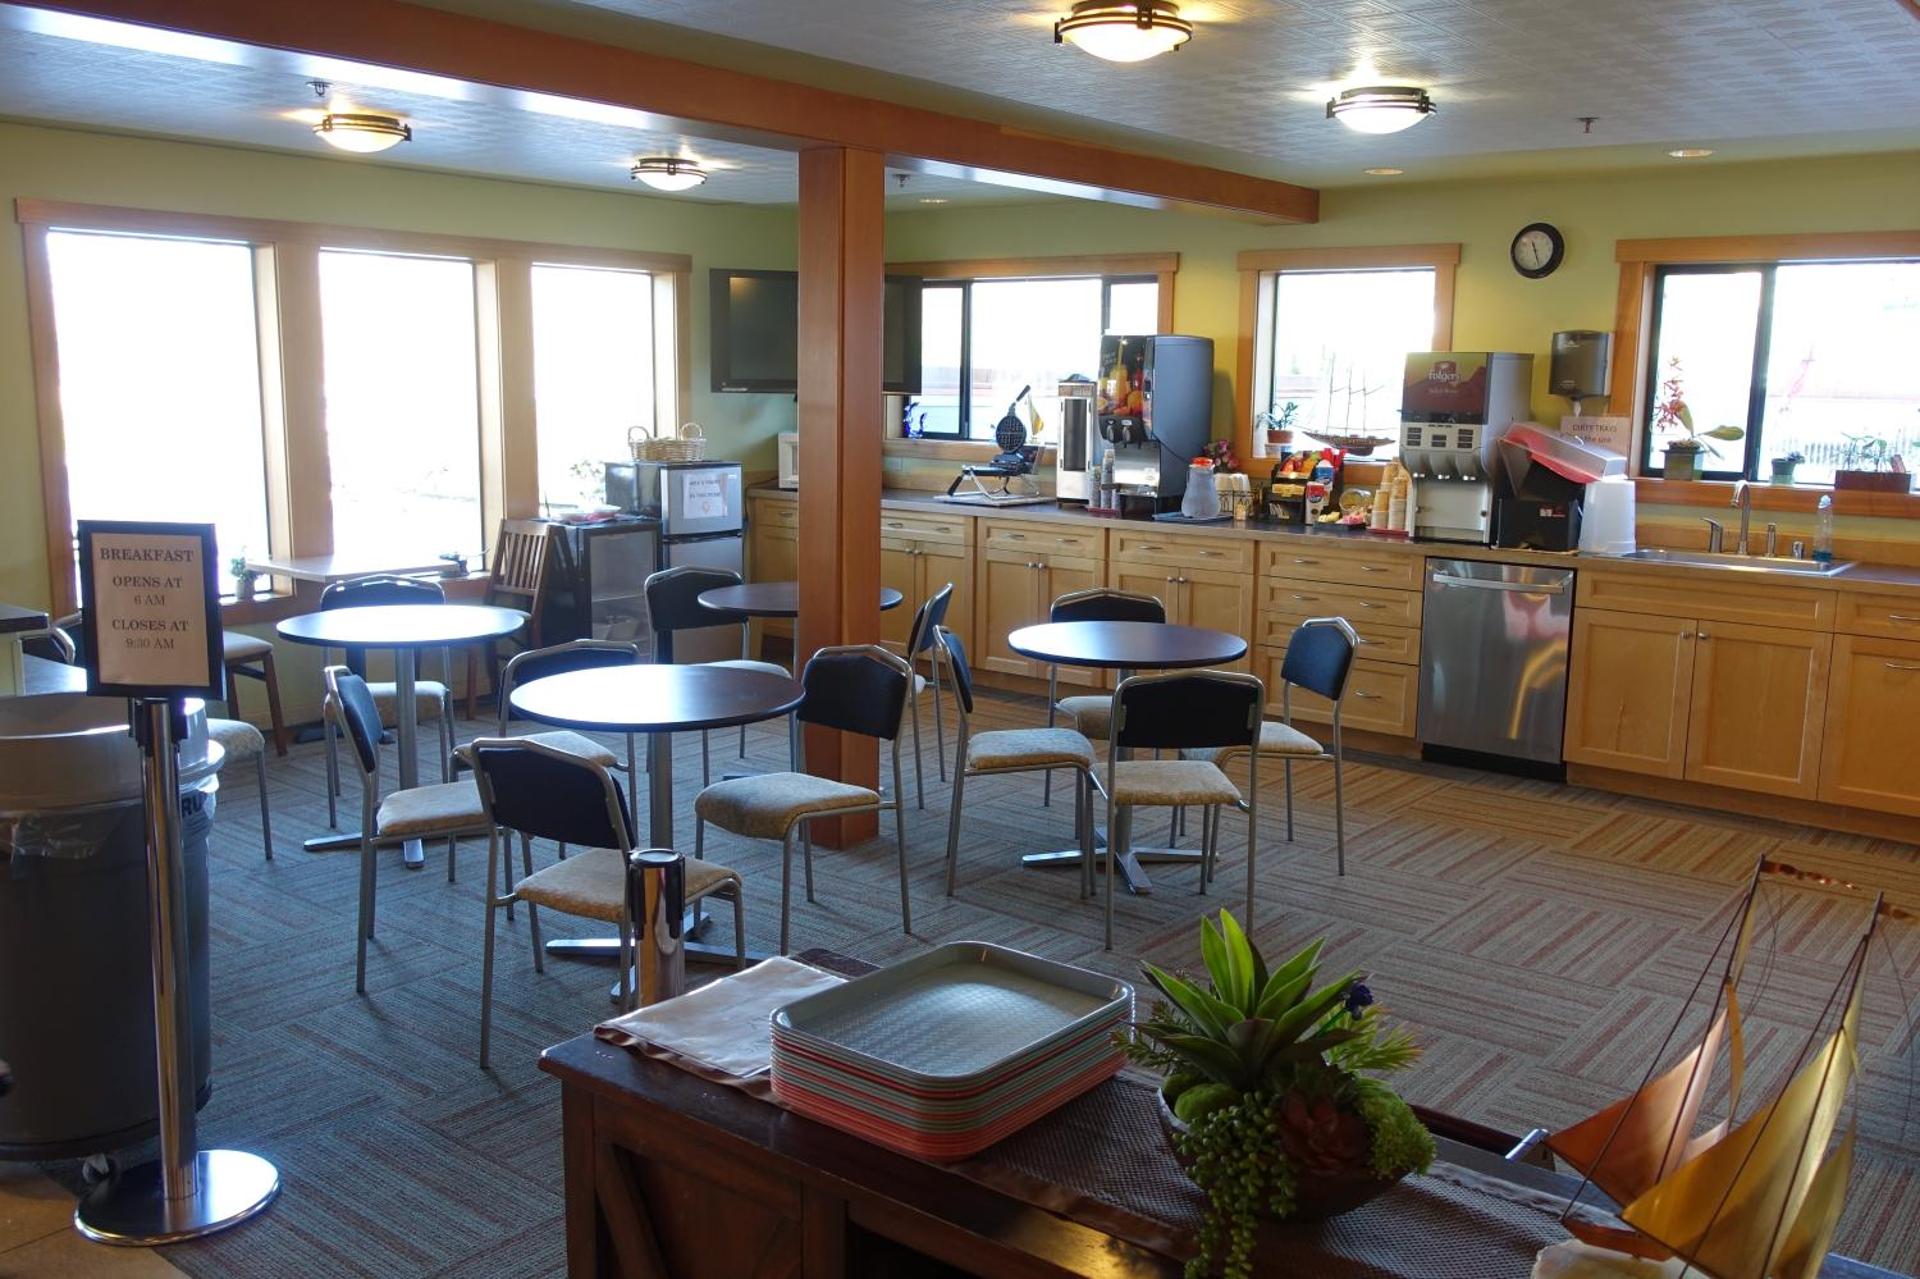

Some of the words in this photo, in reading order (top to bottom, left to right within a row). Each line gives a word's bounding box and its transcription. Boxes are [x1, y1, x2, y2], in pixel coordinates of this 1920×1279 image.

[101, 548, 193, 562] BREAKFAST
[112, 575, 160, 588] OPENS
[164, 577, 182, 588] AT
[134, 595, 142, 605] 6
[146, 595, 165, 606] AM
[112, 618, 166, 631] CLOSES
[170, 620, 188, 632] AT
[154, 638, 174, 649] AM
